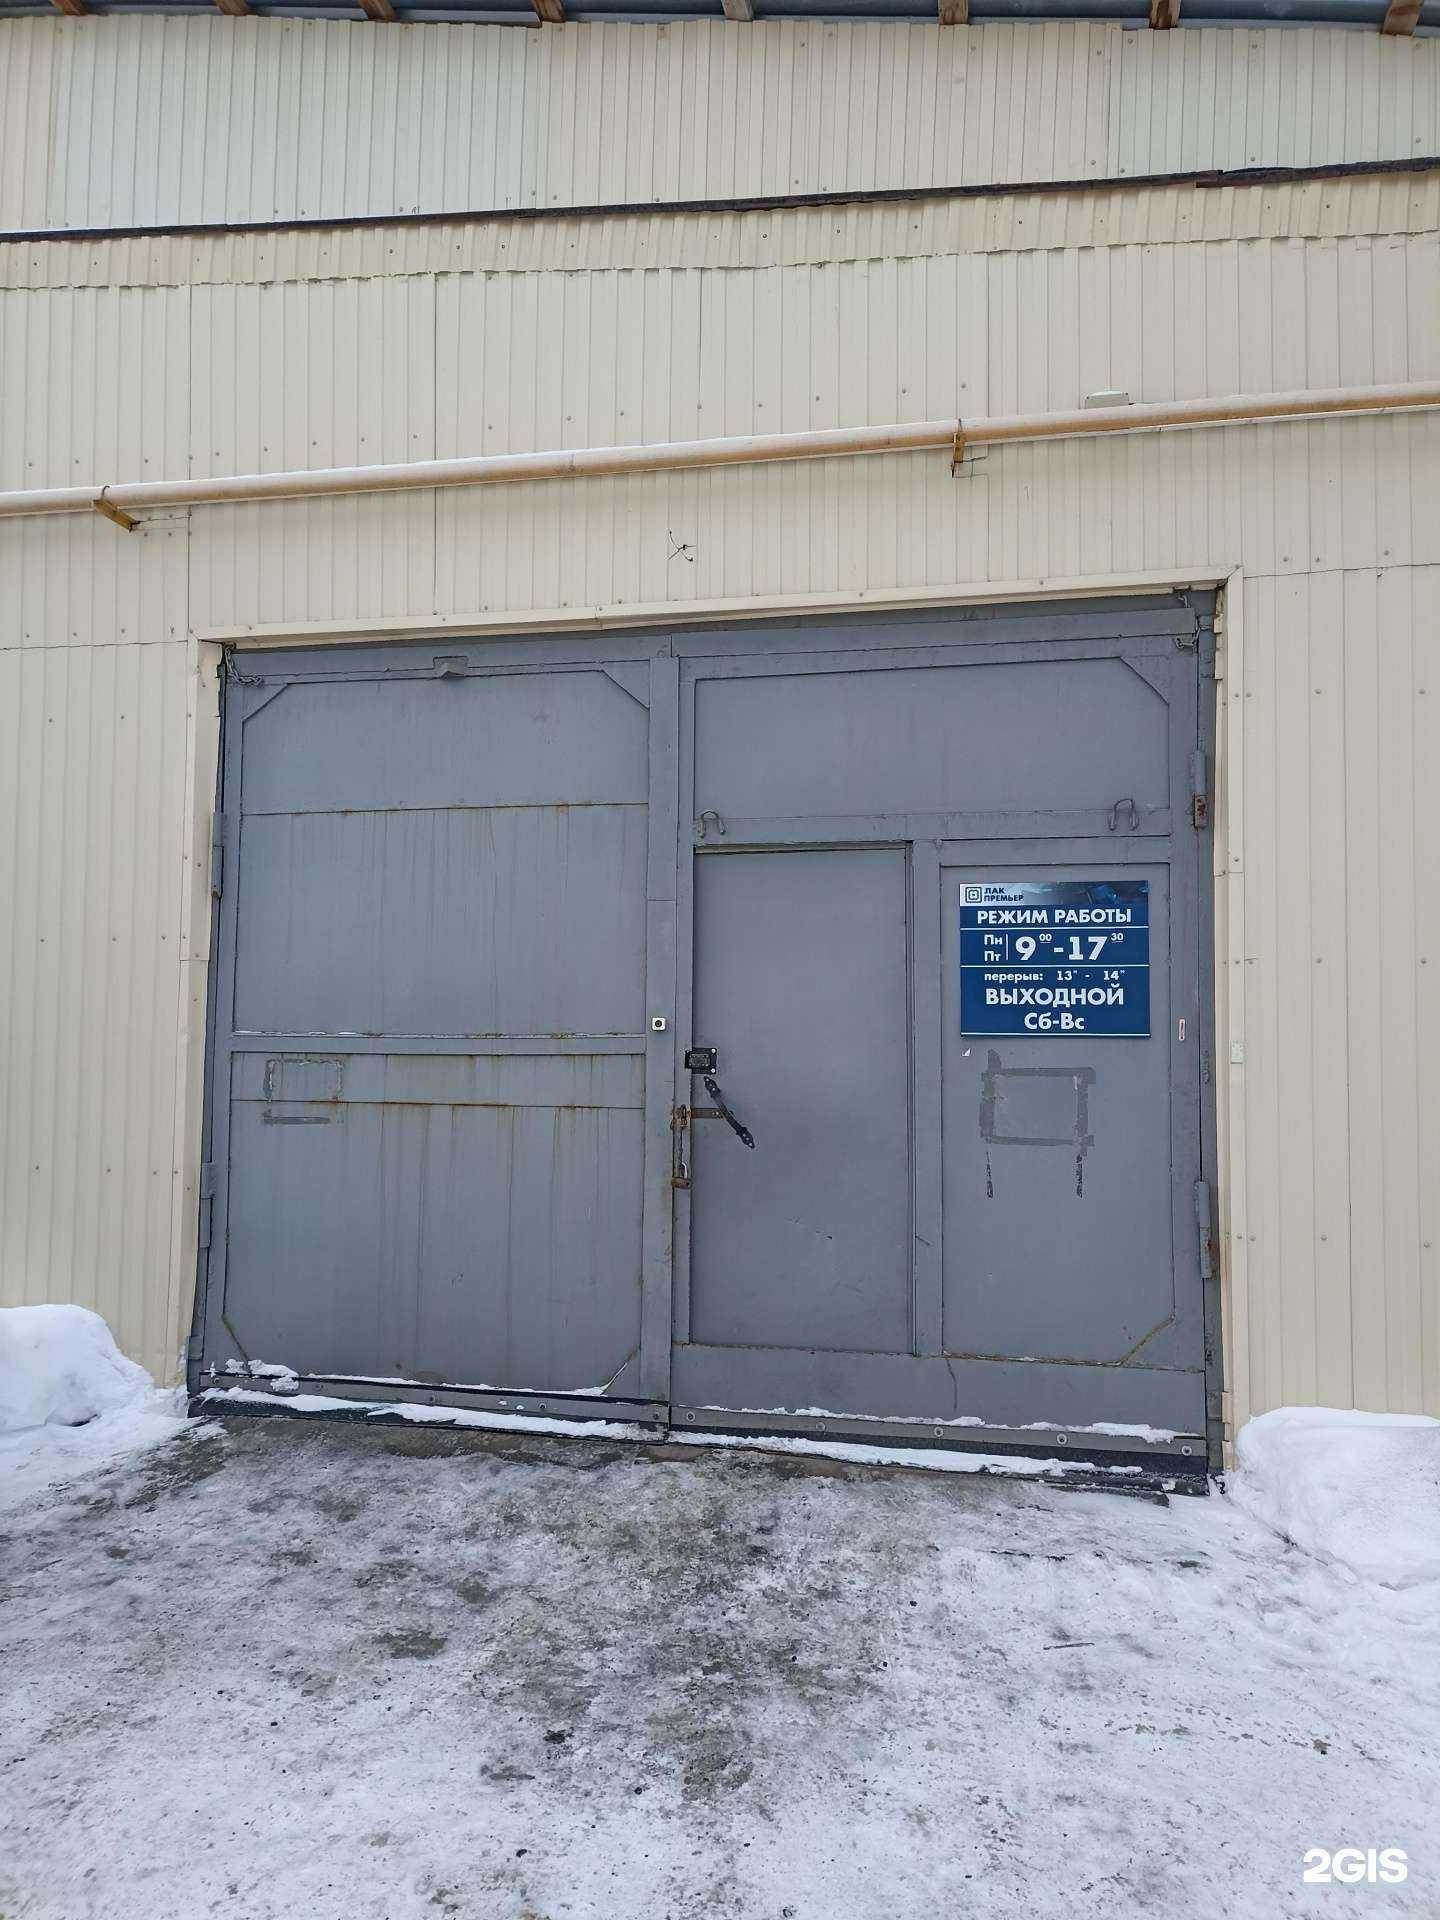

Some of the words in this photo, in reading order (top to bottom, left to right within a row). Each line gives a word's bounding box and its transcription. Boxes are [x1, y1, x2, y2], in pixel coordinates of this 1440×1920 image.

[977, 910, 1049, 924] РЕЖИМ
[1054, 909, 1131, 923] РАБОТЫ
[984, 934, 1003, 945] Пн
[984, 950, 1001, 962] Пт
[984, 972, 1044, 983] перерыв:
[985, 983, 1124, 1007] ВЫХОДНОЙ
[1024, 1013, 1085, 1030] Сб-Вс
